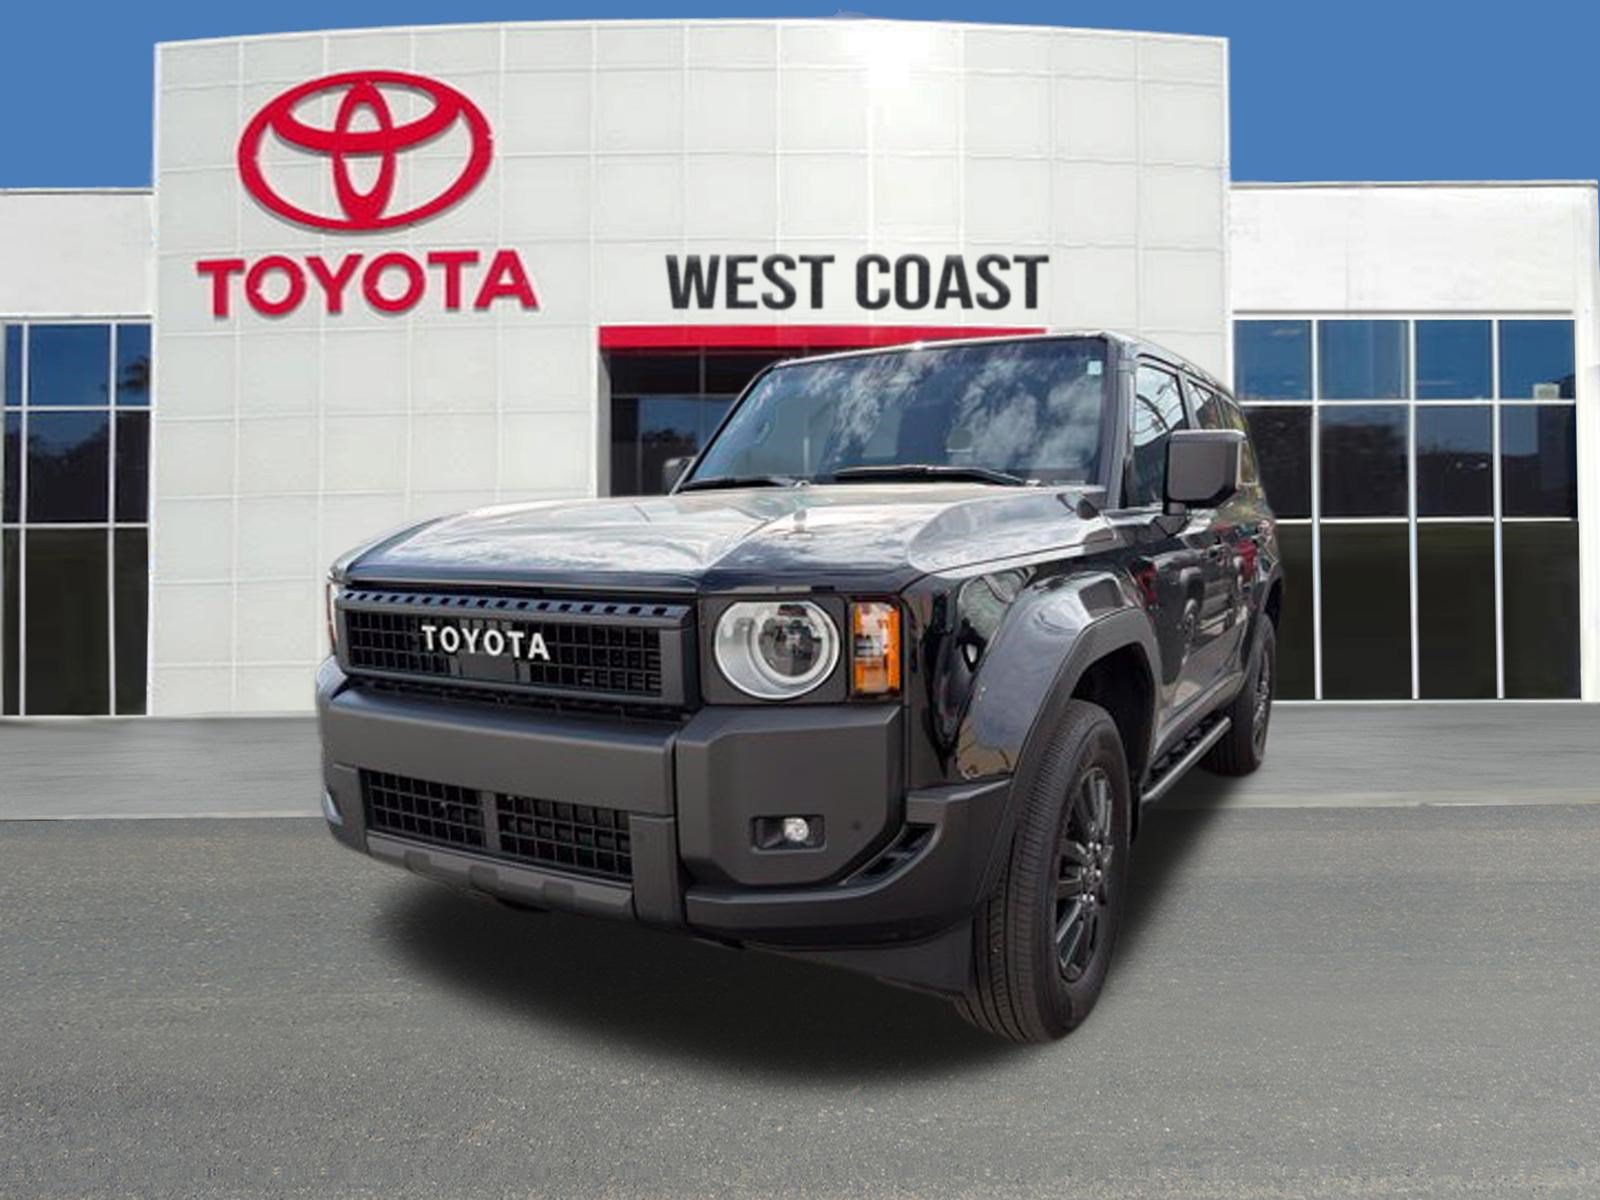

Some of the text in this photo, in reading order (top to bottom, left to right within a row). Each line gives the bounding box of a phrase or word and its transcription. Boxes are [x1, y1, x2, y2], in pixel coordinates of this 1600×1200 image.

[196, 249, 538, 317] TOYOTA
[666, 254, 1049, 310] WEST COAST
[421, 623, 551, 661] TOYOTA
